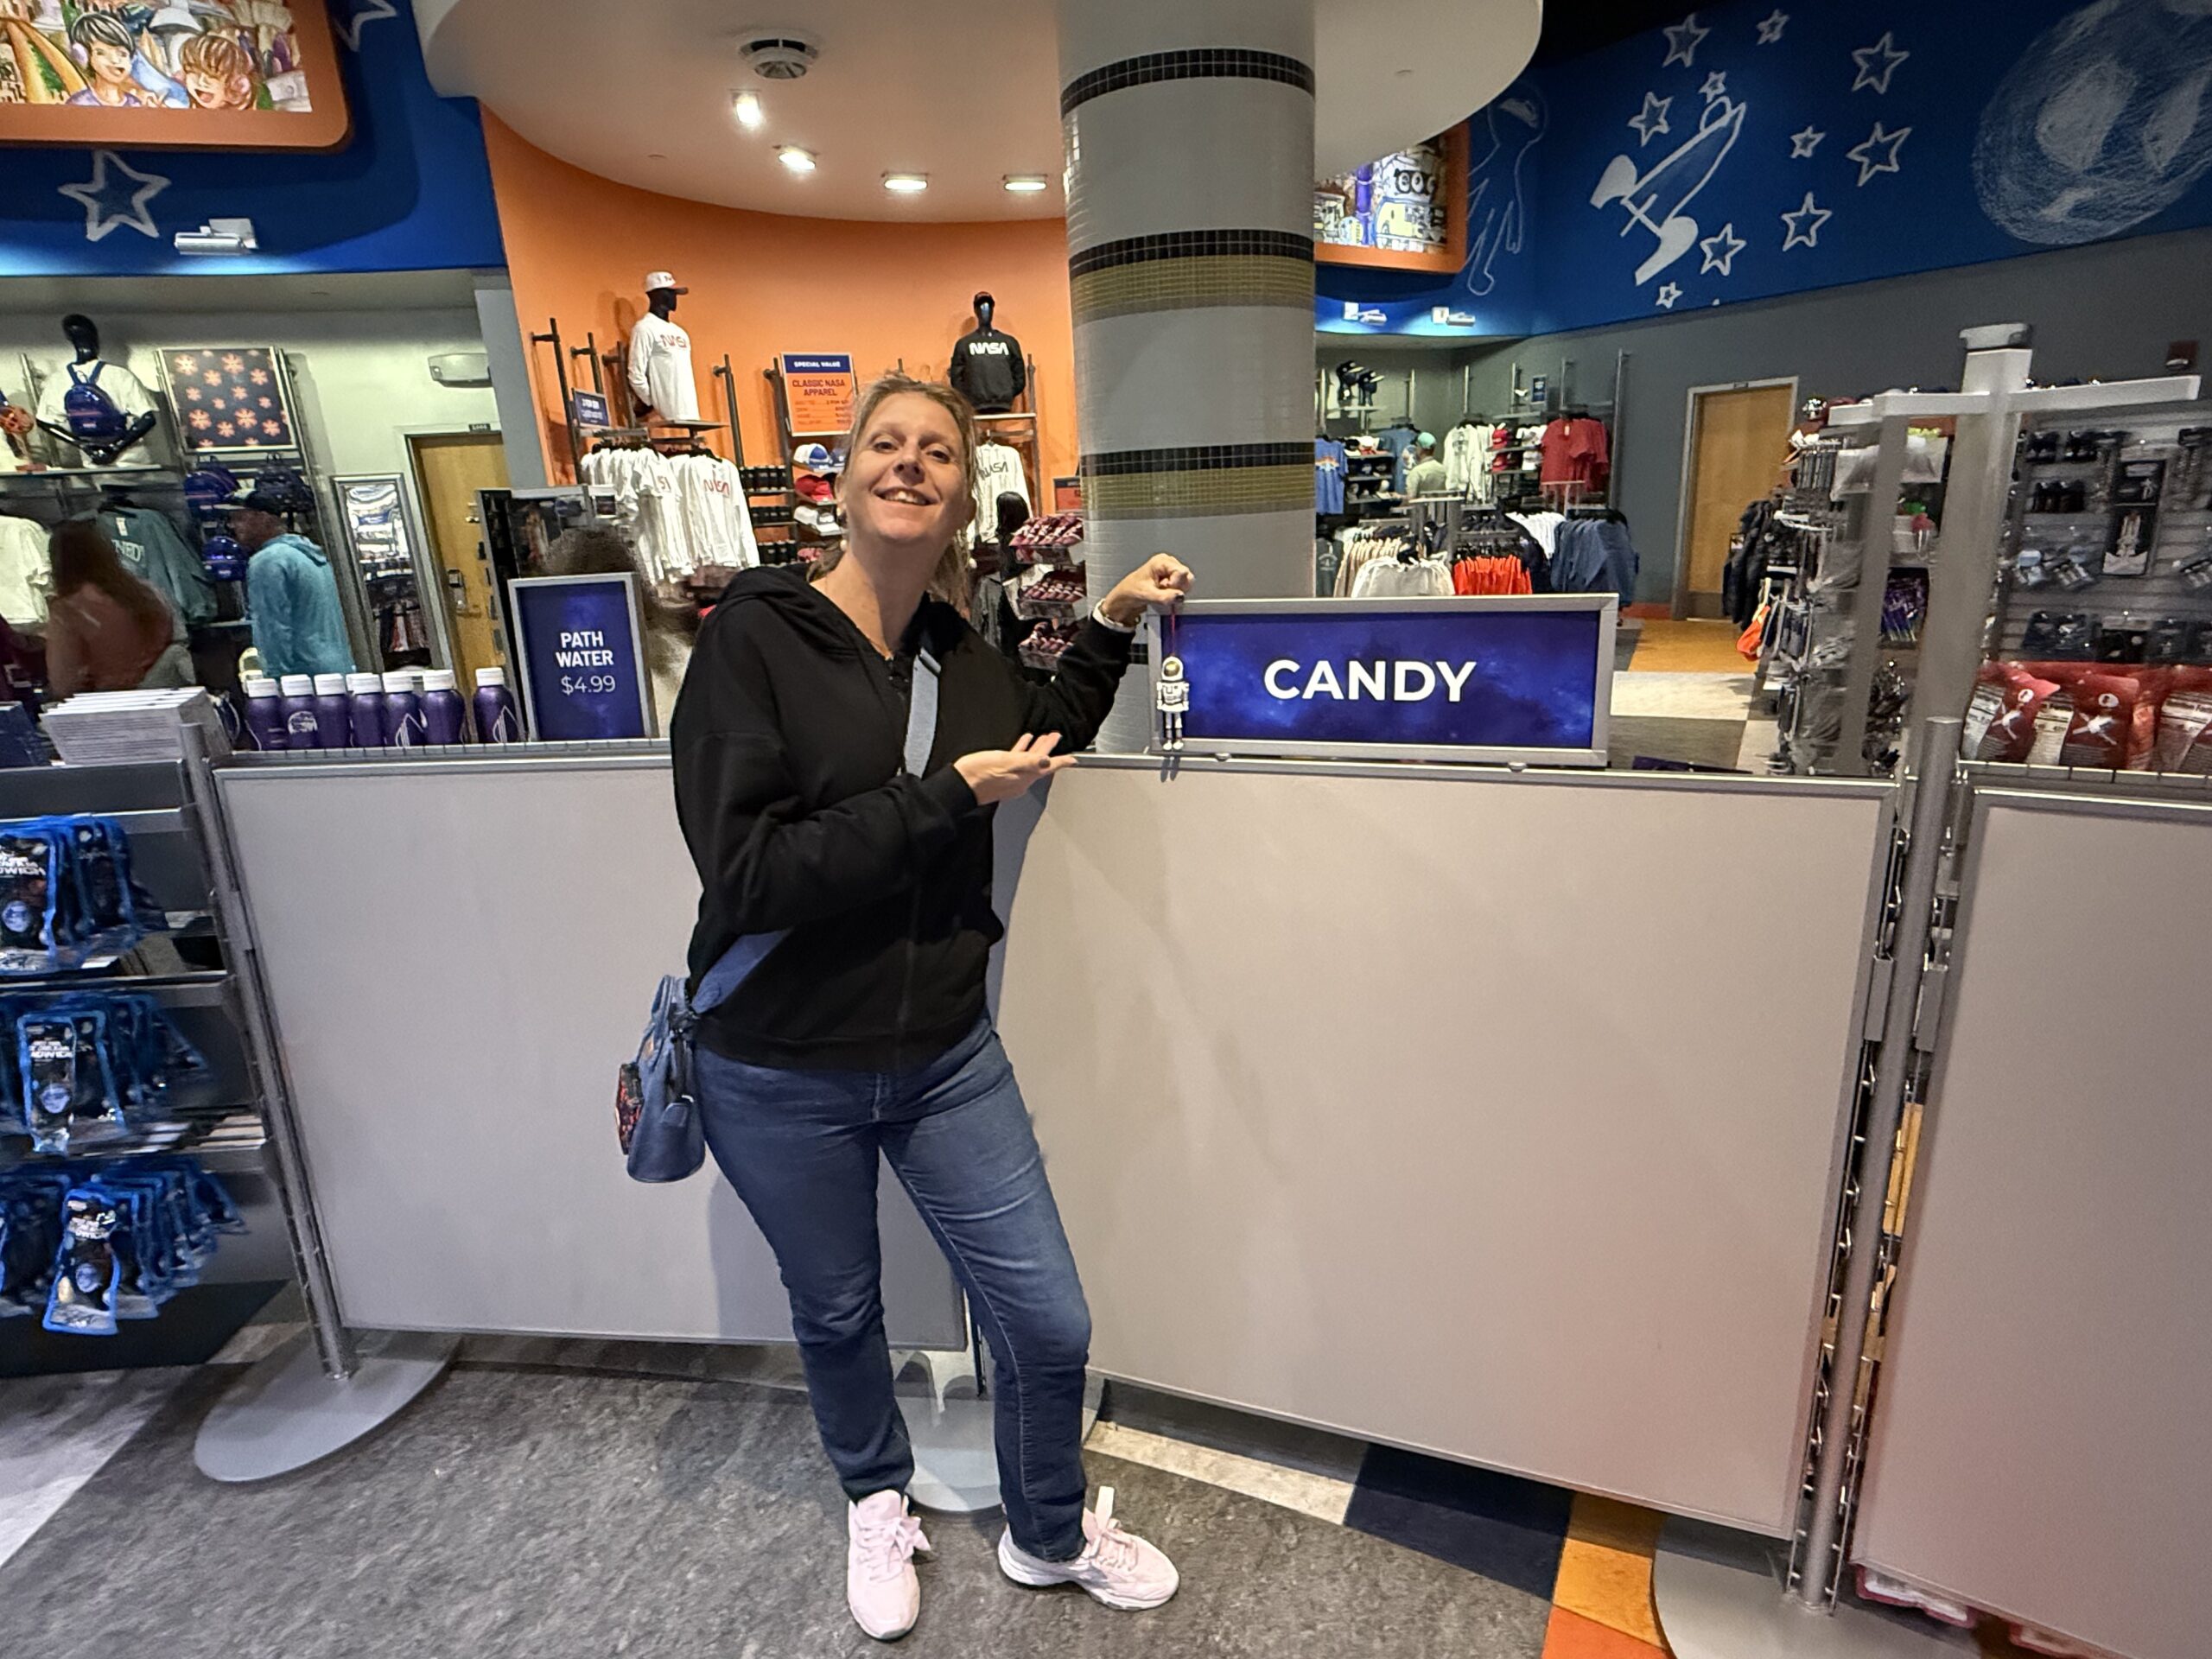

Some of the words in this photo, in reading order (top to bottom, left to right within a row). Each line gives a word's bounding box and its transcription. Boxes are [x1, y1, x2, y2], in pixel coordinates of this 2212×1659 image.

[969, 341, 1010, 356] NASA
[791, 379, 824, 388] CLASSIC
[824, 378, 846, 387] NASA
[804, 388, 838, 397] APPAREL
[560, 631, 604, 648] PATH
[555, 650, 614, 668] WATER
[561, 675, 616, 696] $4.99
[1263, 659, 1477, 702] CANDY
